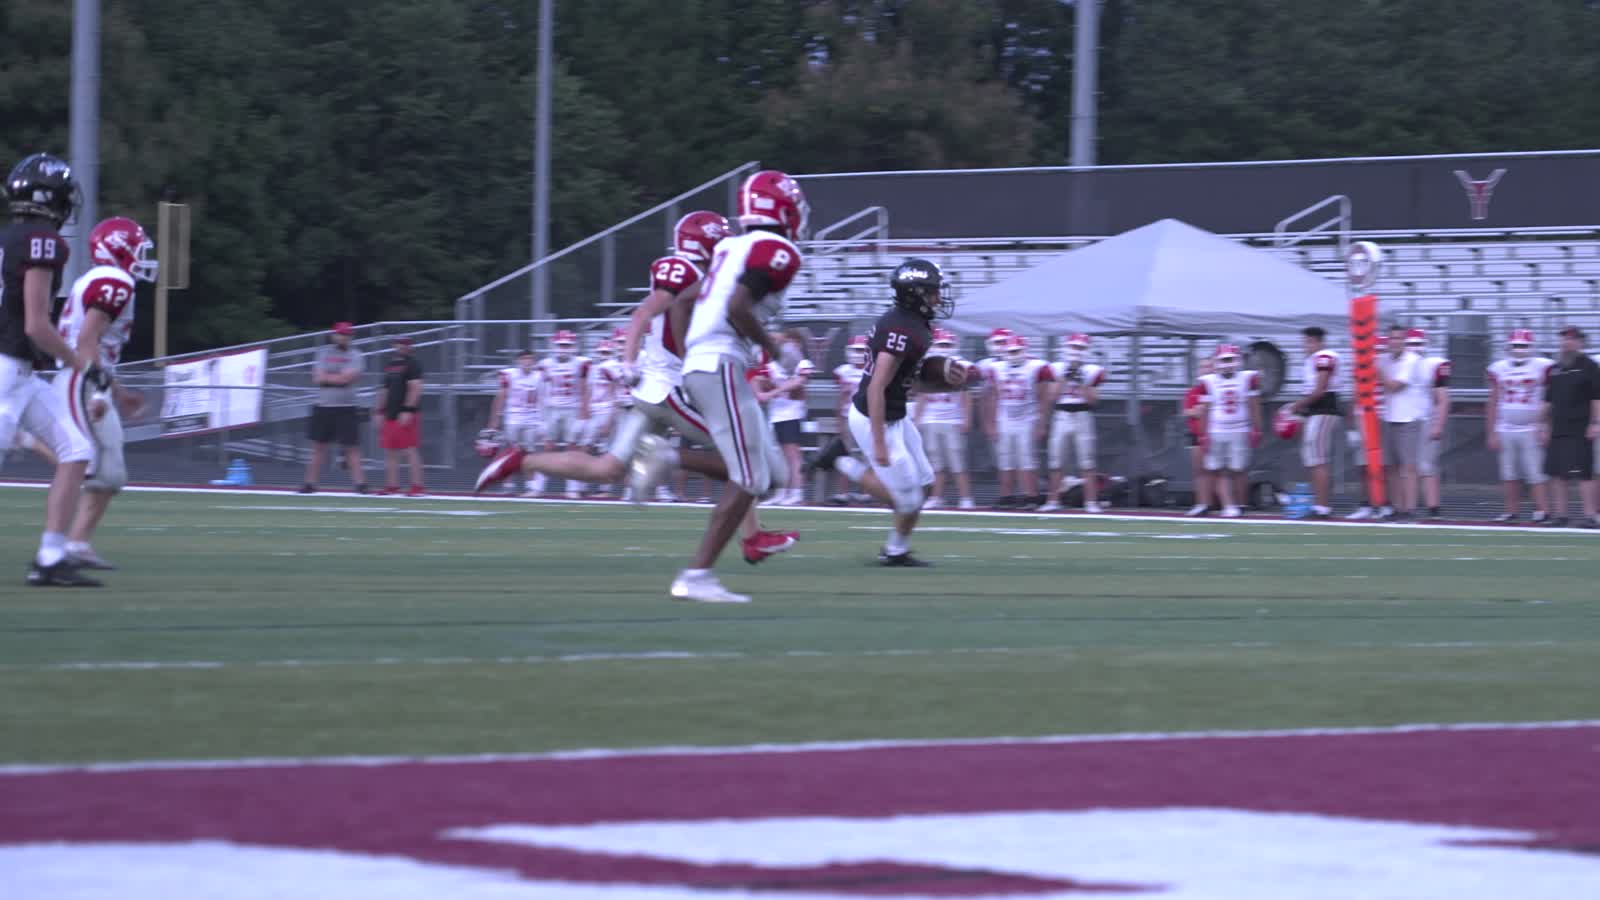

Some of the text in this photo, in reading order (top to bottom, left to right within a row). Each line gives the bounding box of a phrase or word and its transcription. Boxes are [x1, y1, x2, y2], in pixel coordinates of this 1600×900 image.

[31, 237, 56, 260] 89
[769, 248, 791, 271] 8
[655, 262, 686, 285] 22
[97, 283, 129, 307] 32
[886, 331, 908, 352] 25
